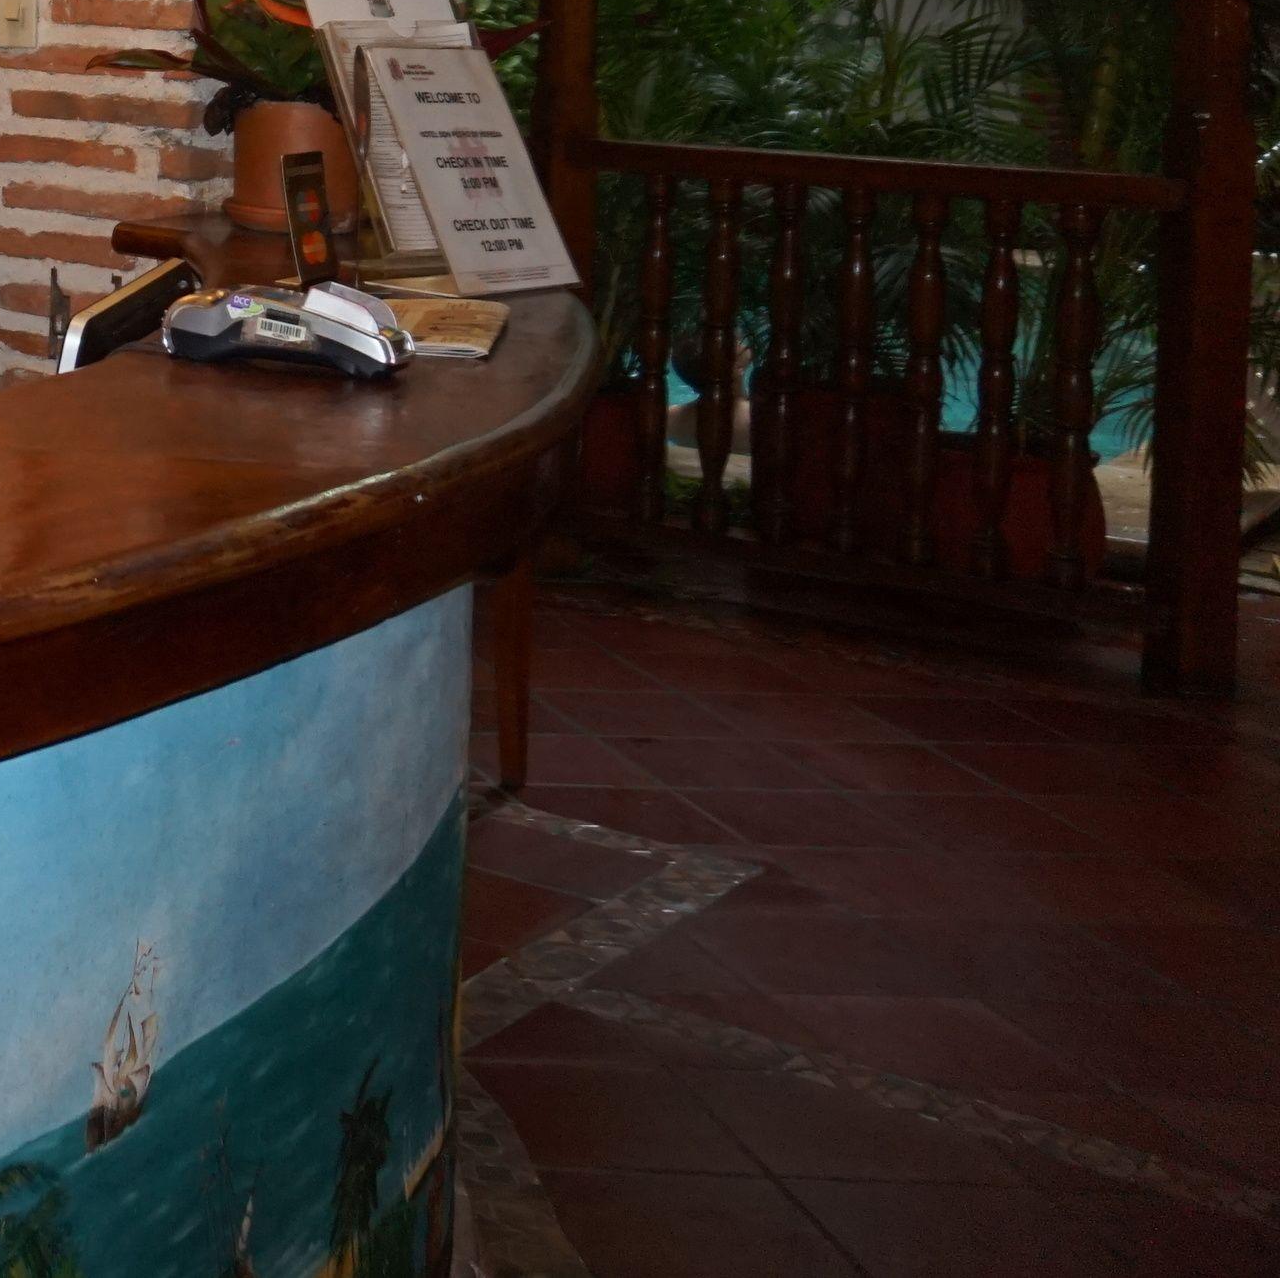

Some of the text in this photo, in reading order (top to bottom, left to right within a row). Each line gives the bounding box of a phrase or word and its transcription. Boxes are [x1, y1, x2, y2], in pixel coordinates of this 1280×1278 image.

[415, 91, 481, 104] WELCOME TO
[436, 155, 509, 169] CHECK IN TIME
[482, 176, 500, 188] PM
[453, 217, 536, 232] CHECK OUT TIME
[481, 238, 524, 252] 12:00 PM
[233, 295, 251, 306] DCC
